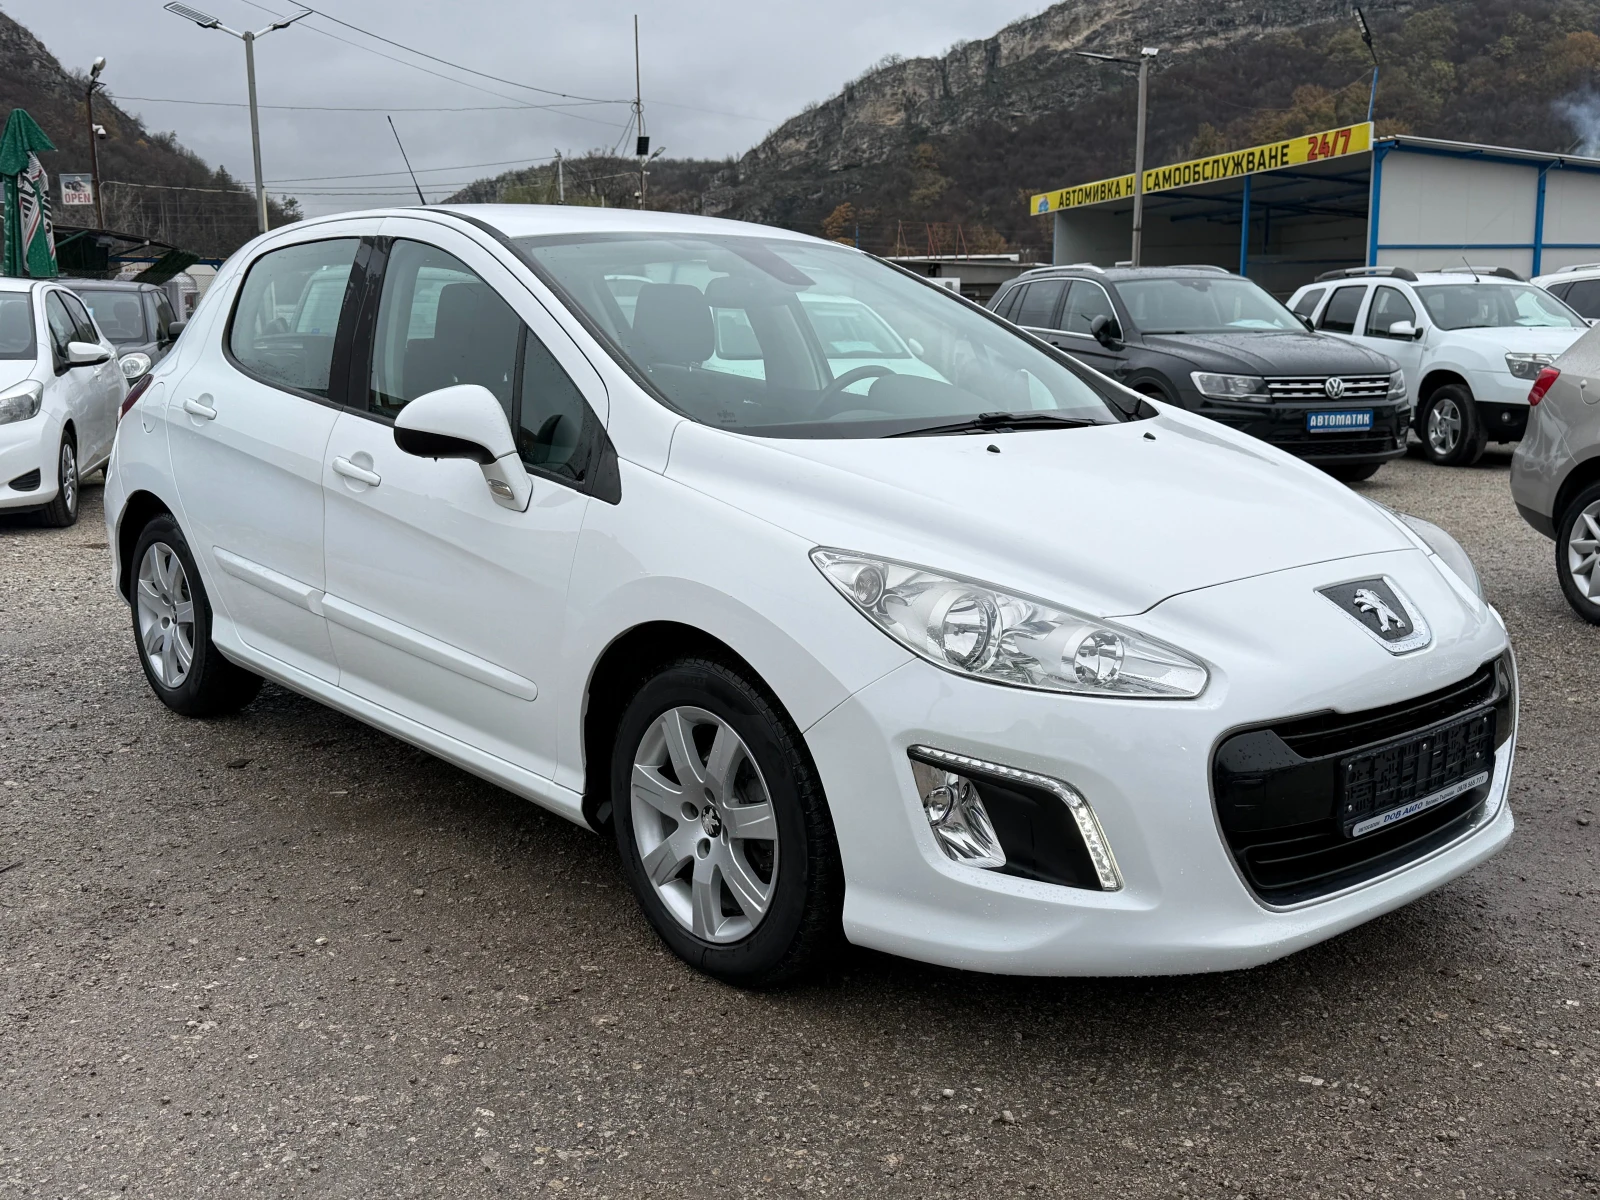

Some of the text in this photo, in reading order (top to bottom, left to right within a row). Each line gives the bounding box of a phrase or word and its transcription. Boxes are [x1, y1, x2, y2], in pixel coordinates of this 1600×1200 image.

[1058, 129, 1351, 208] АВТОМИВКА Н САМООБСЛУЖВАНЕ 24/7
[64, 193, 91, 204] OPEN
[1310, 413, 1370, 427] АВТОМАТИК
